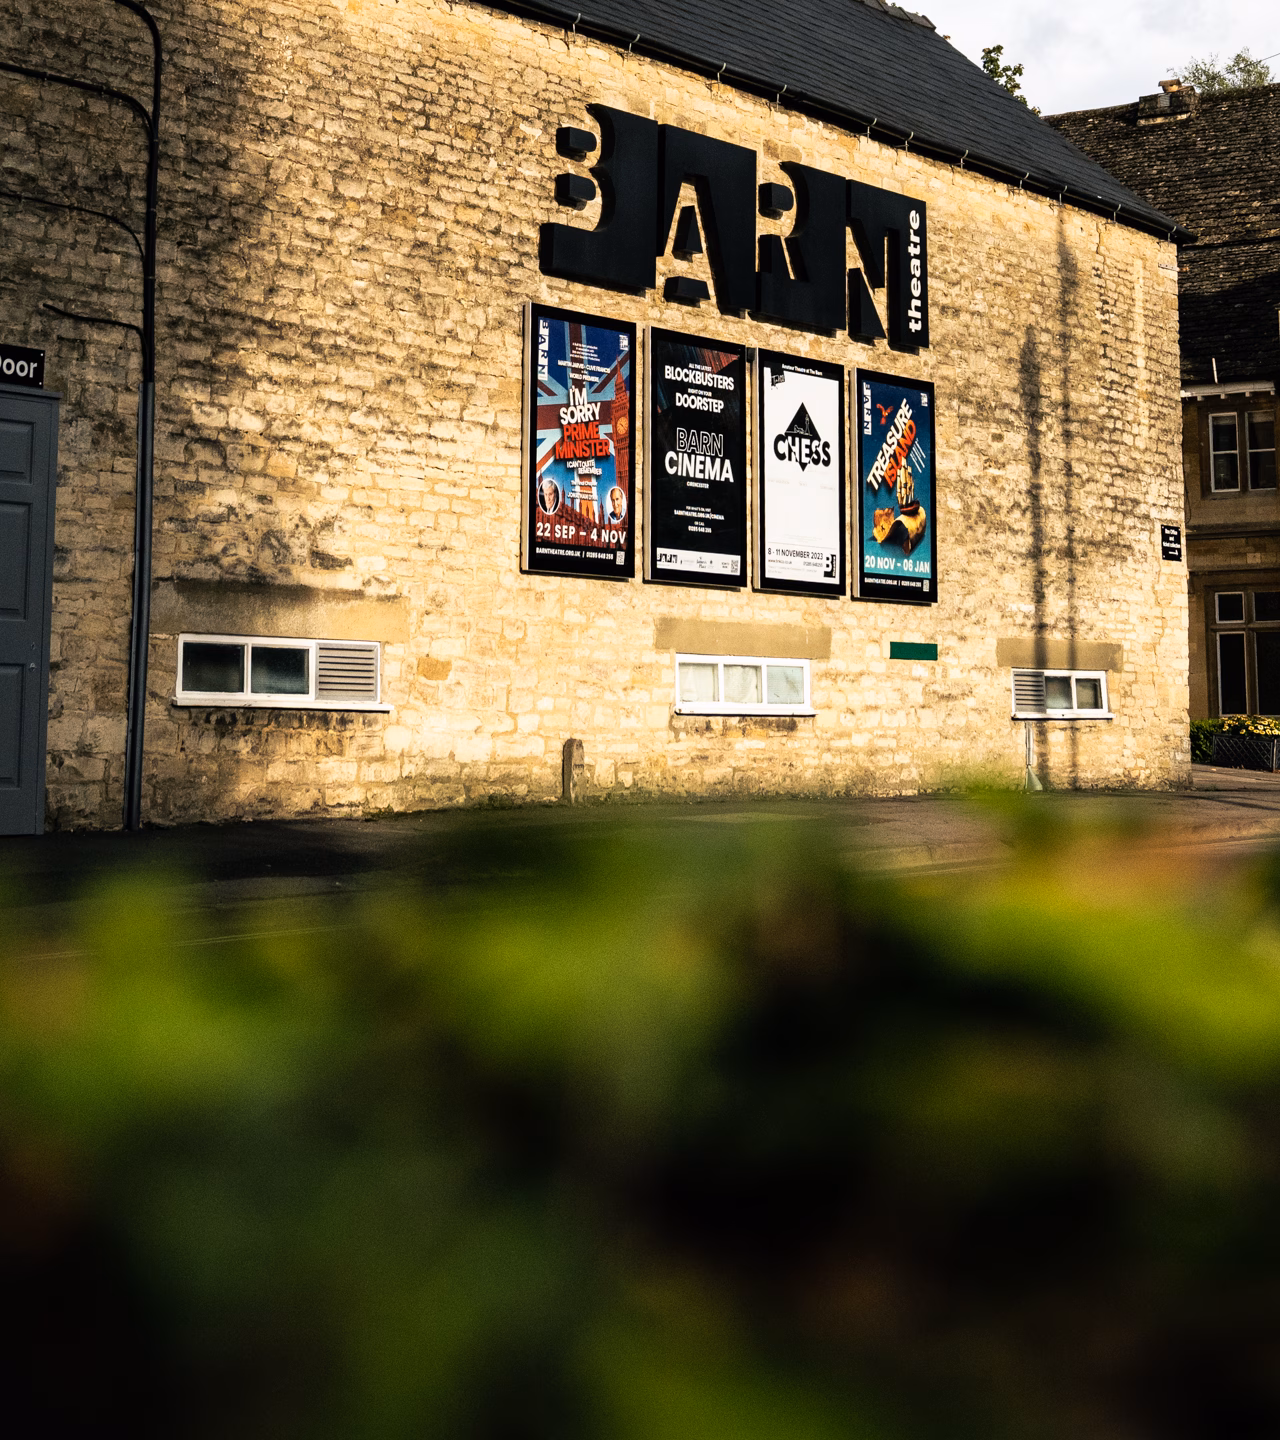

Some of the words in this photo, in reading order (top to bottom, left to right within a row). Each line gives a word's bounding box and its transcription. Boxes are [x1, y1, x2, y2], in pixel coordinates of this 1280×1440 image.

[540, 103, 929, 355] BARN
[907, 209, 922, 333] theatre
[538, 320, 549, 376] BARN
[664, 365, 735, 391] BLOCKBUSTERS
[569, 385, 588, 406] I'M
[675, 392, 724, 413] DOORSTEP
[560, 402, 600, 425] SORRY
[563, 422, 600, 442] PRIME
[677, 427, 724, 457] BARN
[867, 398, 913, 490] TREASURE
[555, 440, 611, 459] MINISTER
[773, 433, 831, 467] CHESS
[884, 420, 916, 488] ISLAND
[664, 451, 734, 483] CINEMA
[536, 522, 551, 537] 22
[555, 524, 576, 539] SEP
[590, 527, 598, 541] 4
[601, 529, 626, 544] NOV
[767, 547, 772, 555] 8
[775, 548, 780, 556] 11
[781, 549, 810, 559] NOVEMBER
[810, 551, 824, 560] 2023
[864, 555, 876, 568] 20
[877, 556, 896, 570] NOV
[903, 559, 914, 572] 06
[914, 560, 930, 574] JAN
